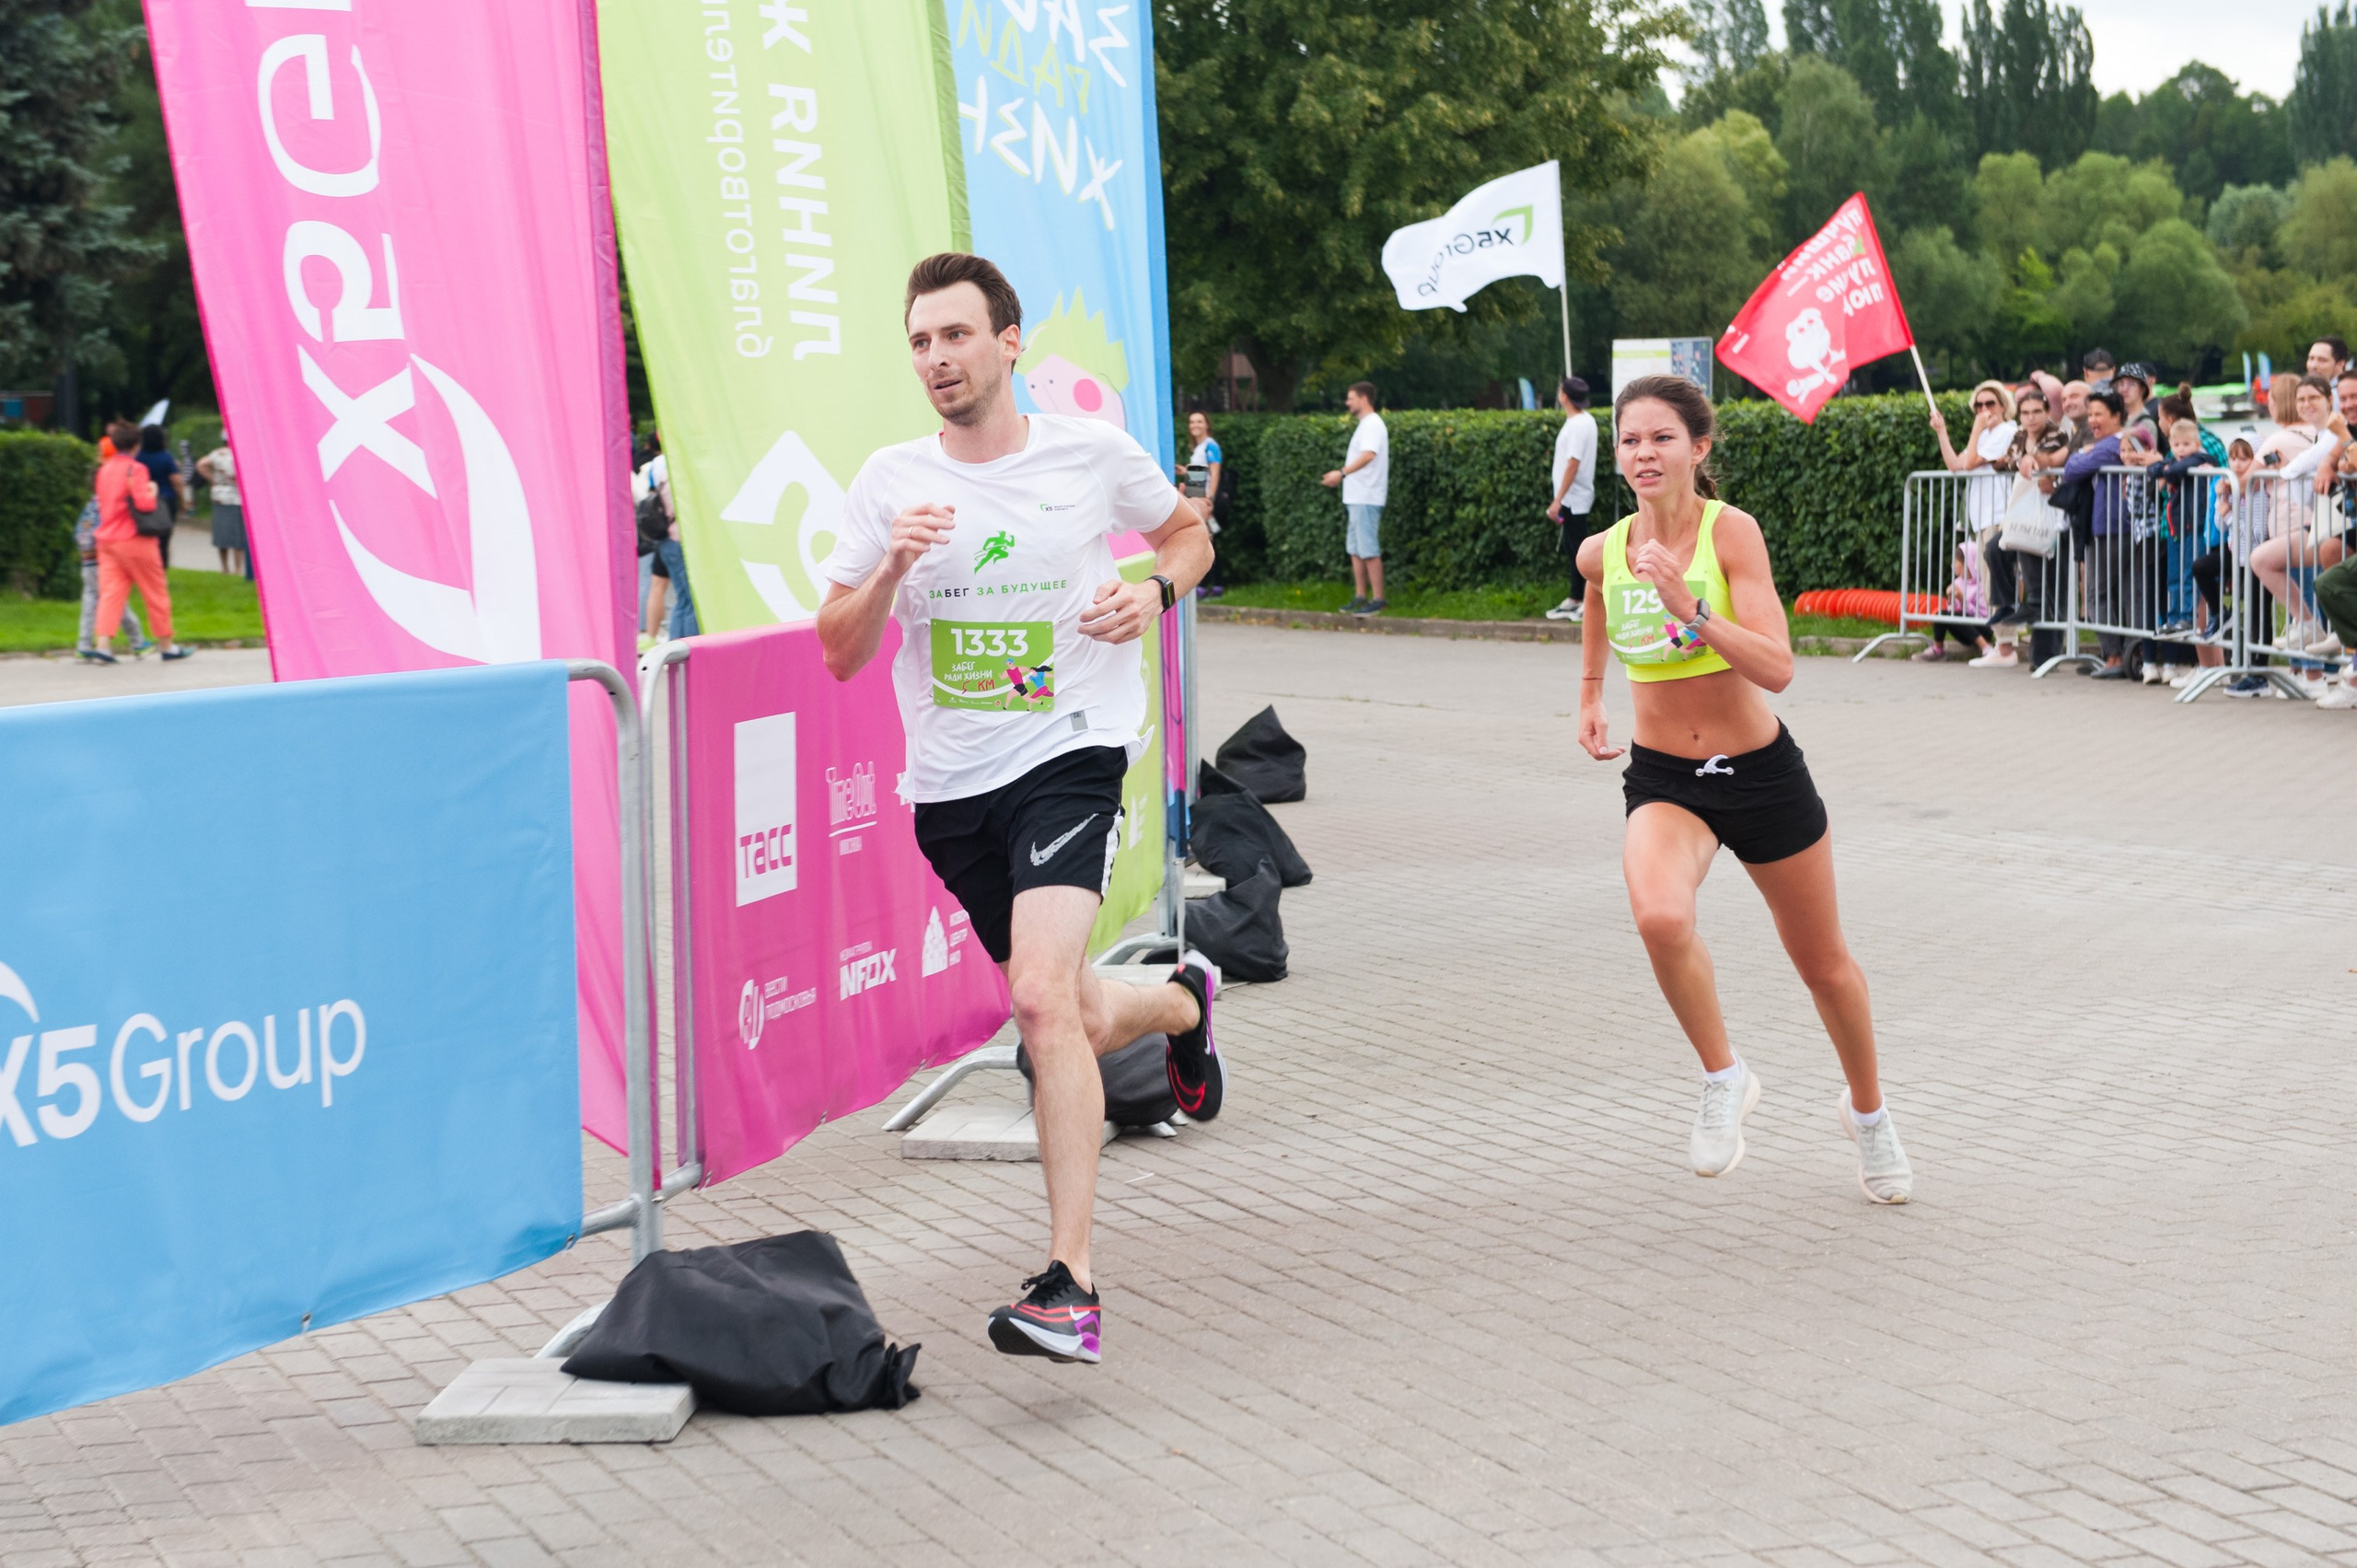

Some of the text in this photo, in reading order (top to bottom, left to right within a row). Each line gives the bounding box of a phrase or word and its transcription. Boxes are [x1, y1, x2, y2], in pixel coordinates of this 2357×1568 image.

[929, 579, 1067, 599] ЗАБЕГ ЗА БУДУЩЕЕ
[1622, 588, 1665, 615] 129
[950, 628, 1029, 657] 1333
[944, 669, 993, 682] РАДИ ЖИЗНИ
[952, 661, 976, 673] ЗАБЕГ
[961, 679, 996, 695] 5 КМ
